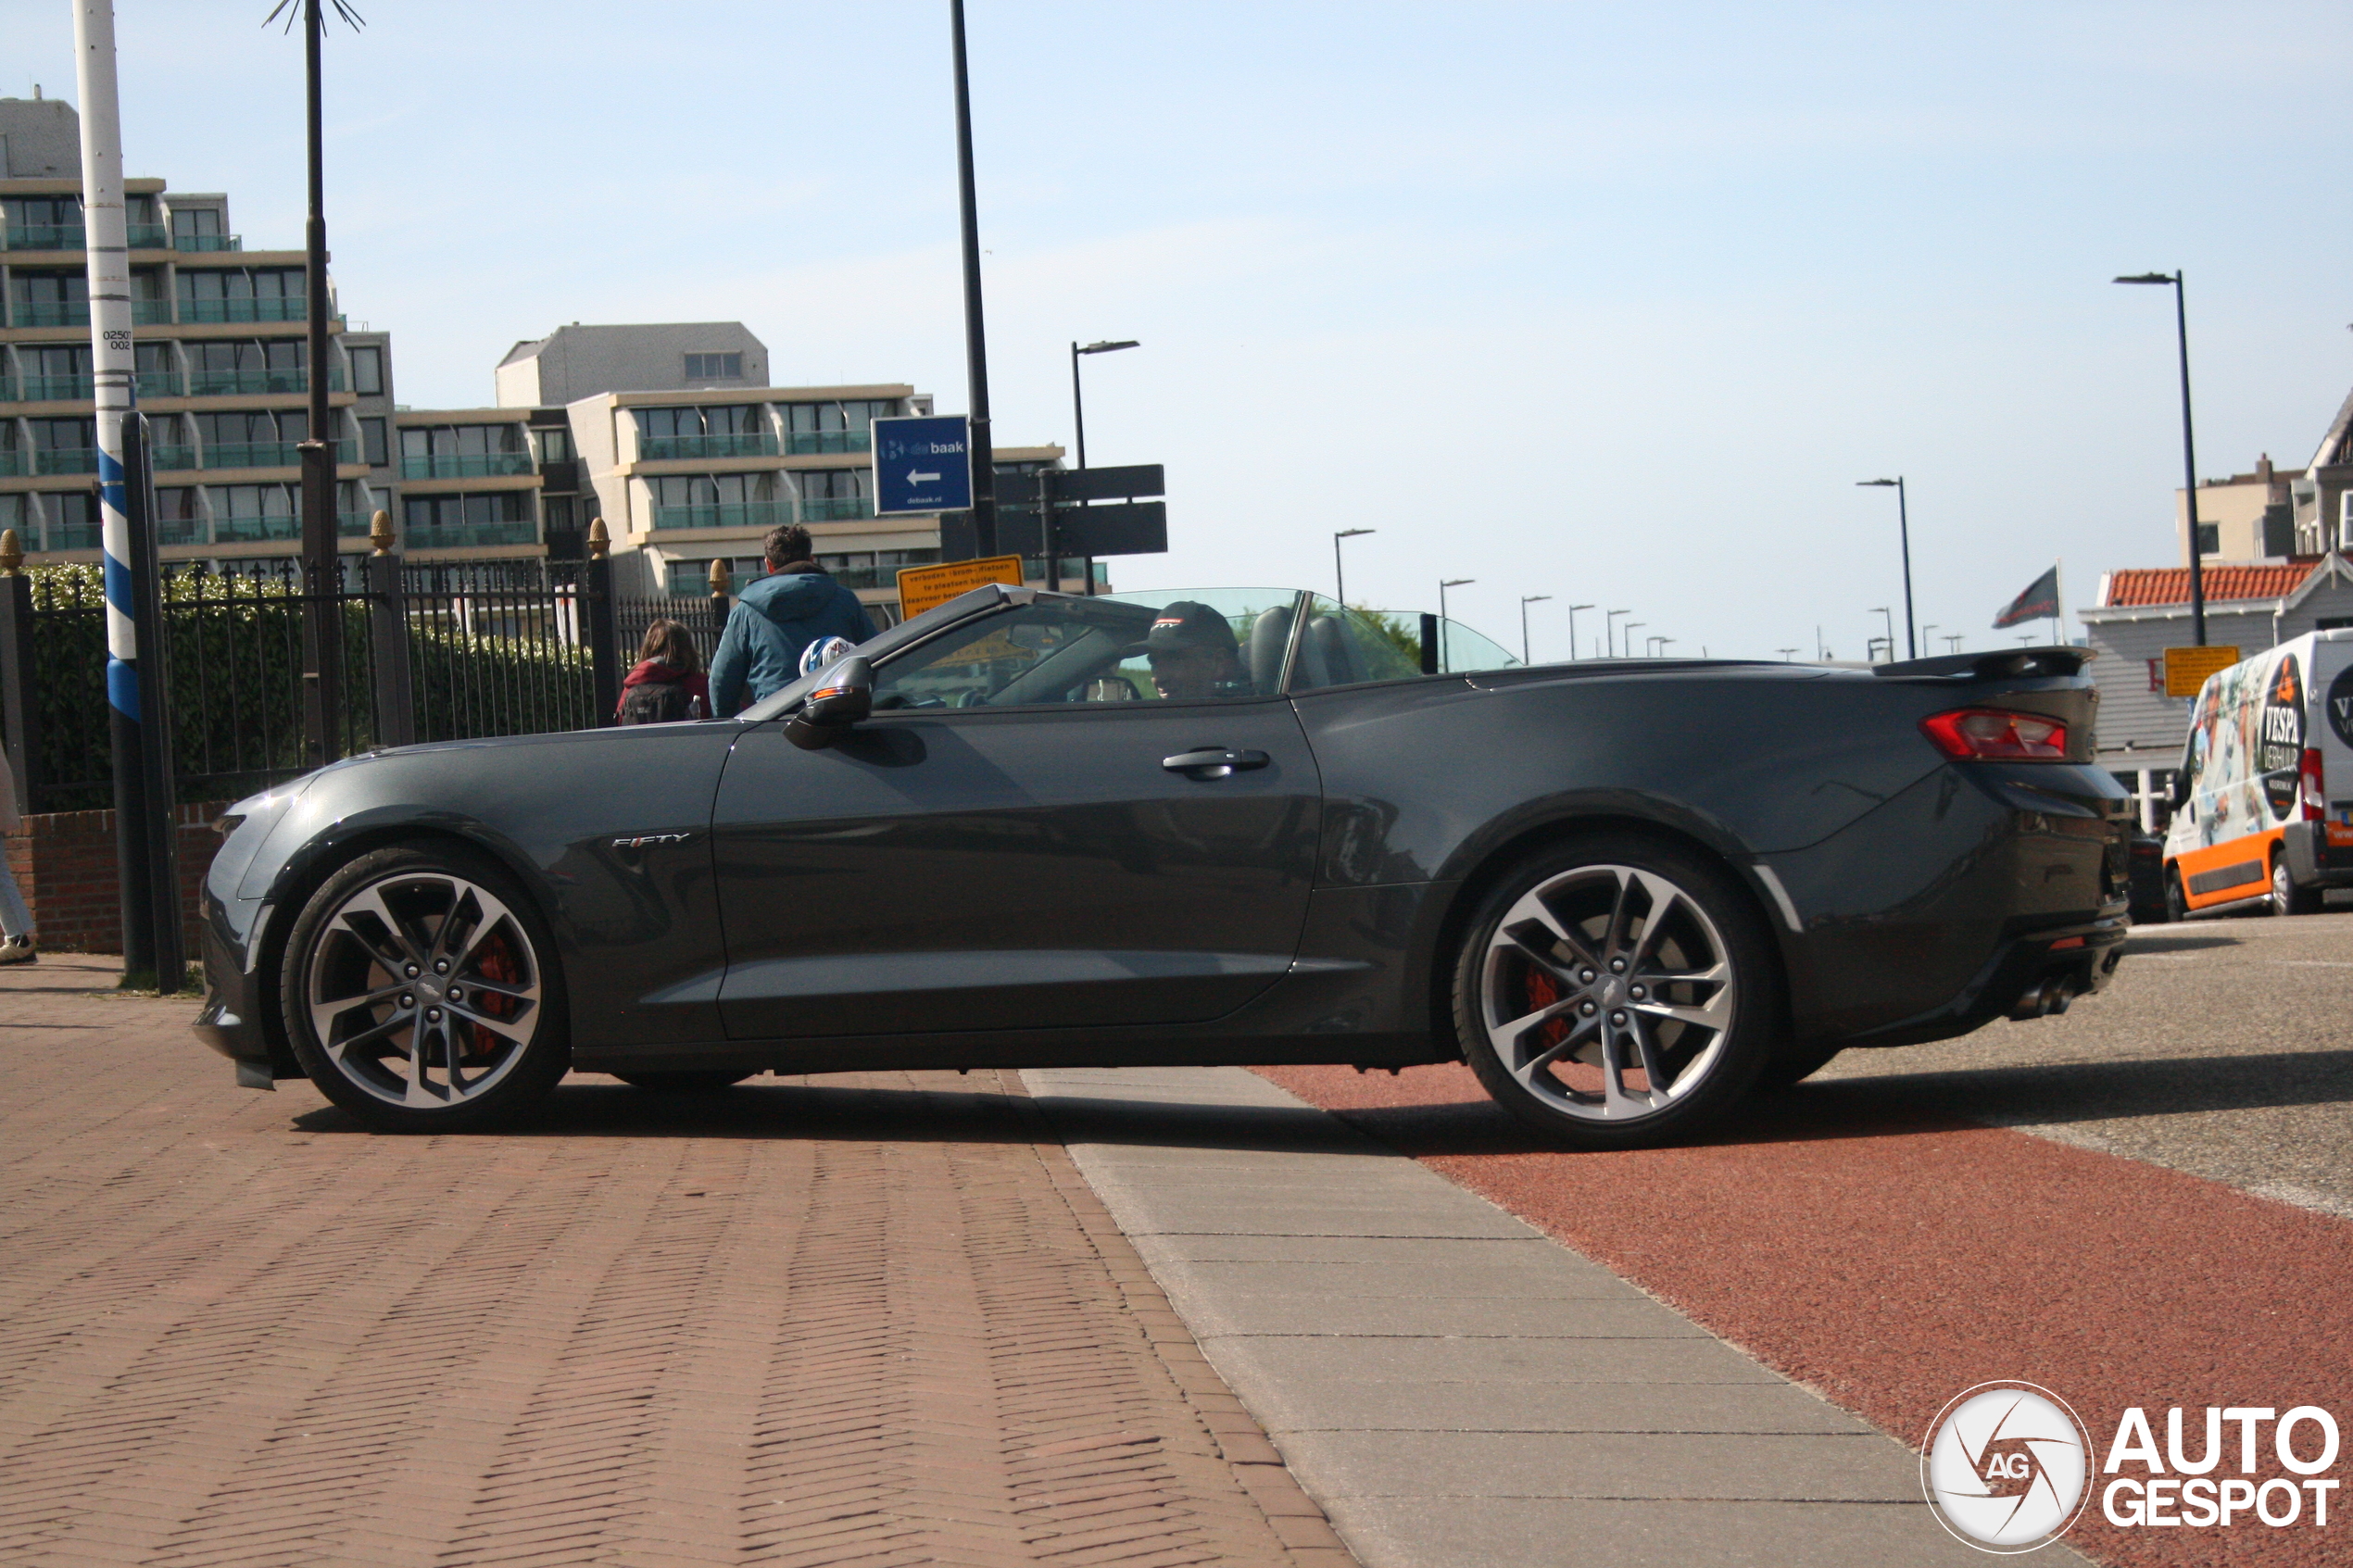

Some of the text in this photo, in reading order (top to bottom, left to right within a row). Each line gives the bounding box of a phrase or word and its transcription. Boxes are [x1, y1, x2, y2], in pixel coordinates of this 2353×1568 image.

[110, 341, 130, 350] 002
[930, 441, 963, 454] baak
[907, 496, 942, 505] debaak.nl
[909, 571, 946, 583] verboden
[934, 579, 968, 591] plaatsen
[970, 575, 998, 585] buiten
[905, 594, 940, 605] daarvoor
[2265, 706, 2299, 745] VESPA
